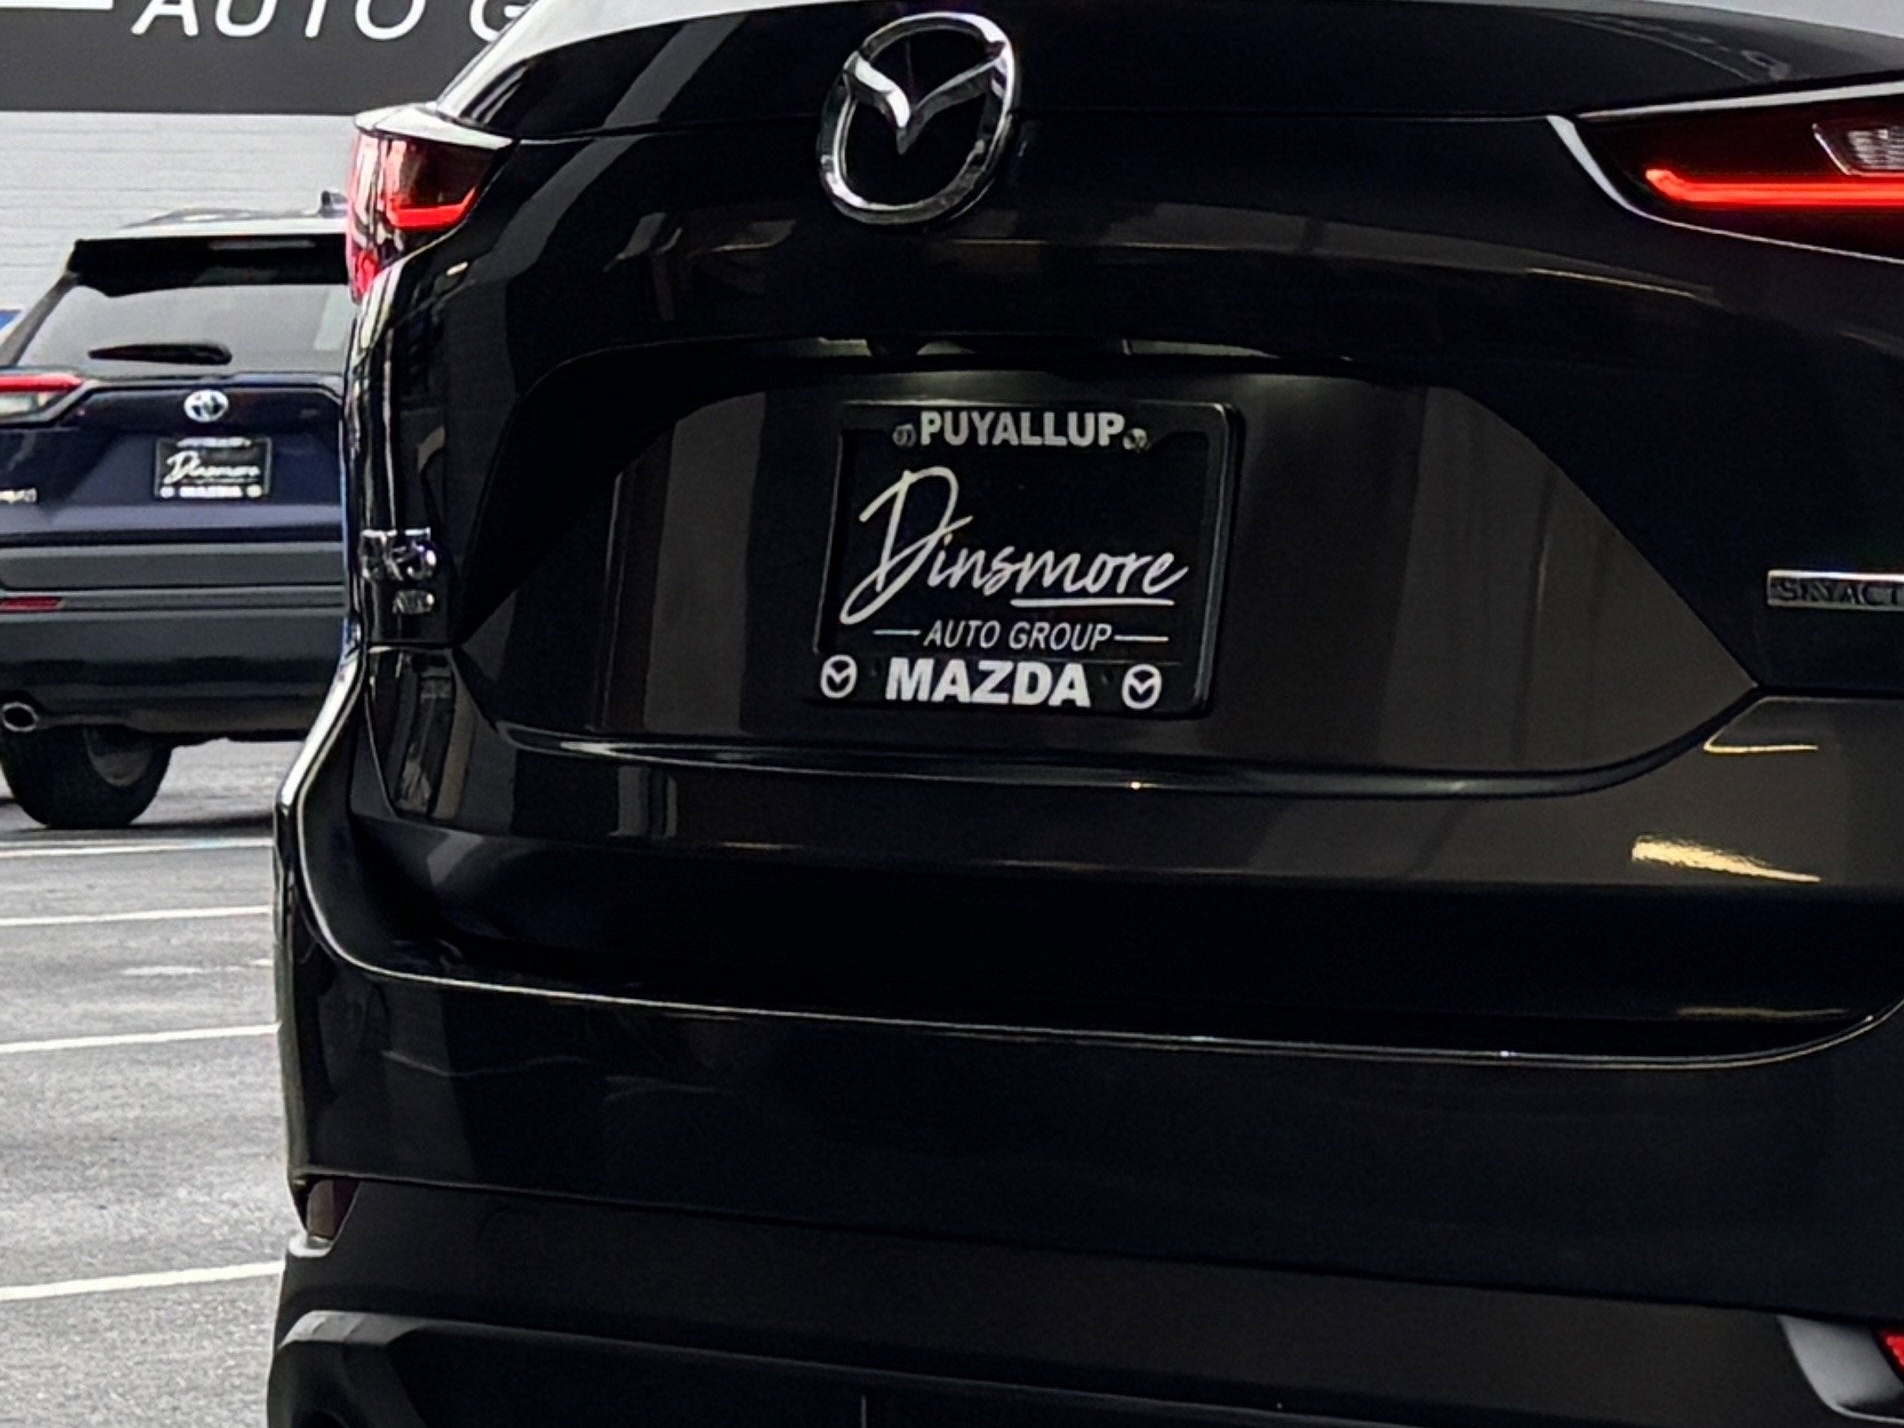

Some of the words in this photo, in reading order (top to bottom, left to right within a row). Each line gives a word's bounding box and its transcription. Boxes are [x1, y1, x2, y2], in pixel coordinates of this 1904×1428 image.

[920, 411, 1125, 447] PUYALLUP
[840, 466, 1189, 625] Dinsmore
[923, 619, 1001, 649] AUTO
[1008, 620, 1113, 652] GROUP
[885, 657, 1092, 708] MAZDA
